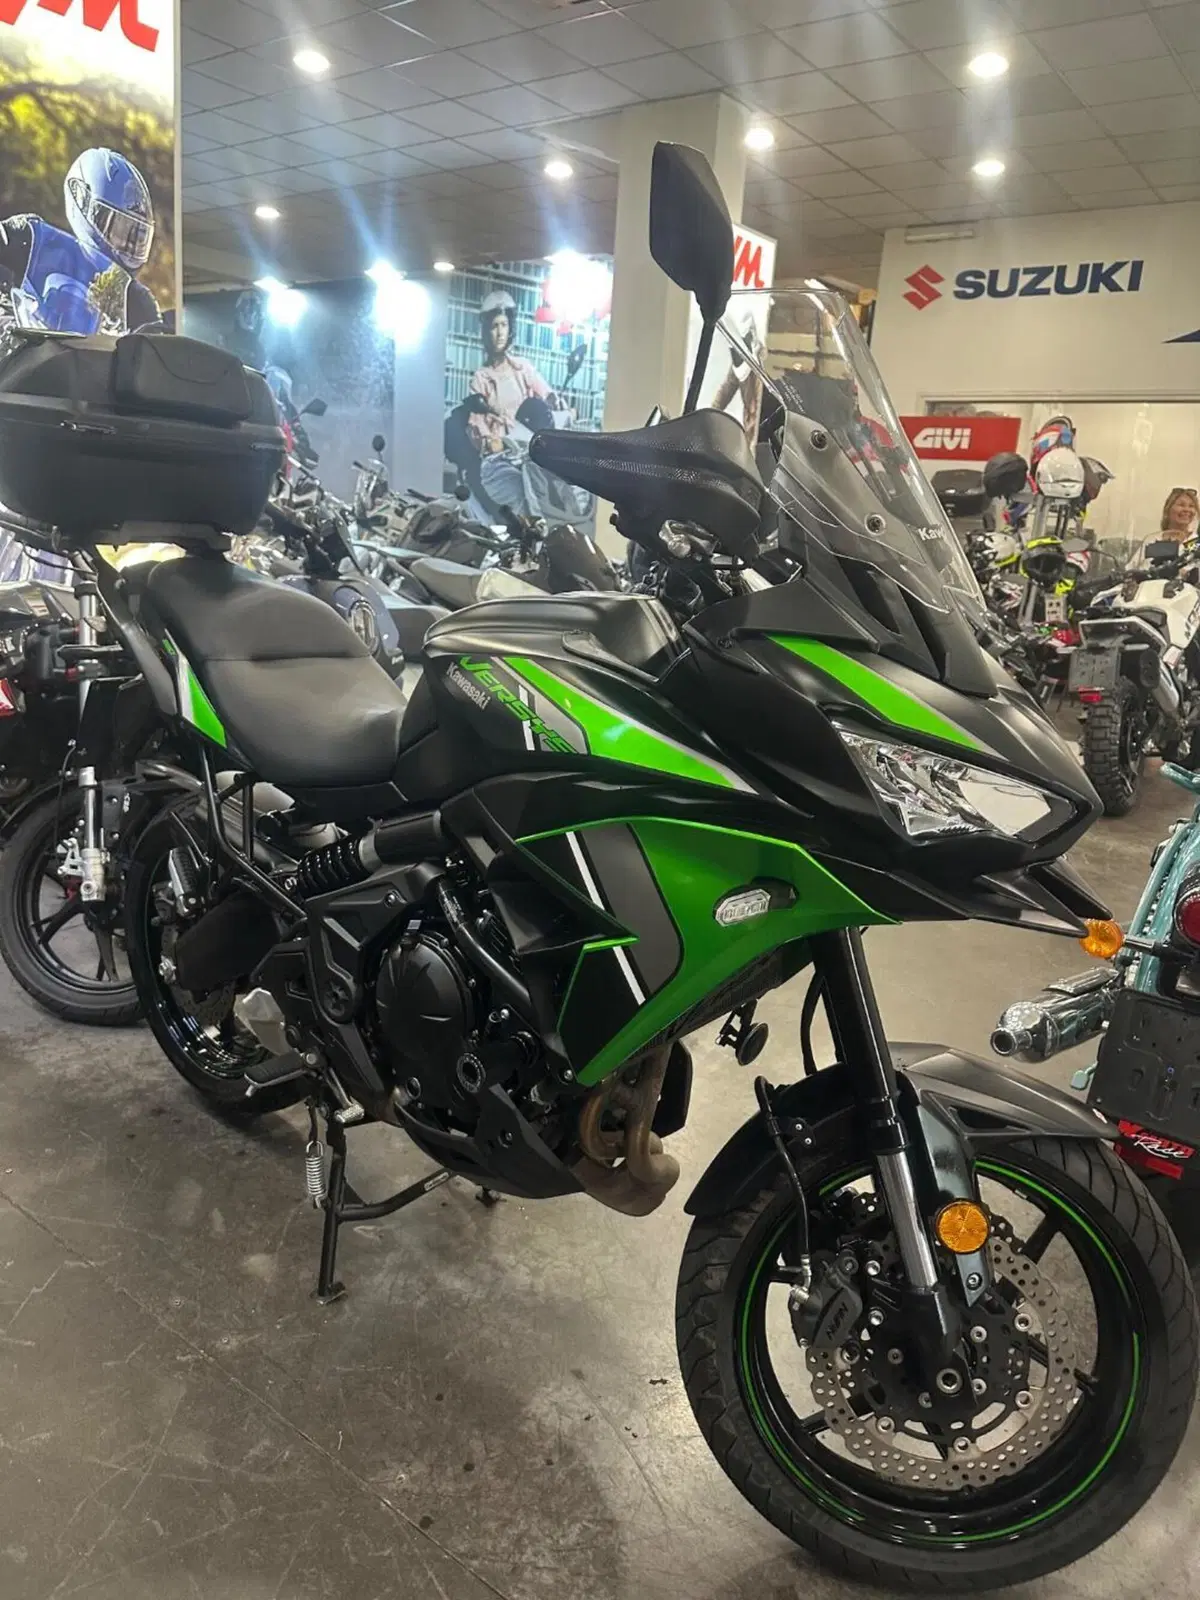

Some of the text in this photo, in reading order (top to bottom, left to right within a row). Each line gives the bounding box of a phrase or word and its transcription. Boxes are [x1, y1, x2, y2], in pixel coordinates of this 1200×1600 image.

[953, 260, 1144, 300] SUZUKI
[913, 427, 971, 451] GIVI
[446, 662, 491, 710] Kawasaki
[459, 656, 579, 754] VERSYS
[1131, 1134, 1189, 1159] Race
